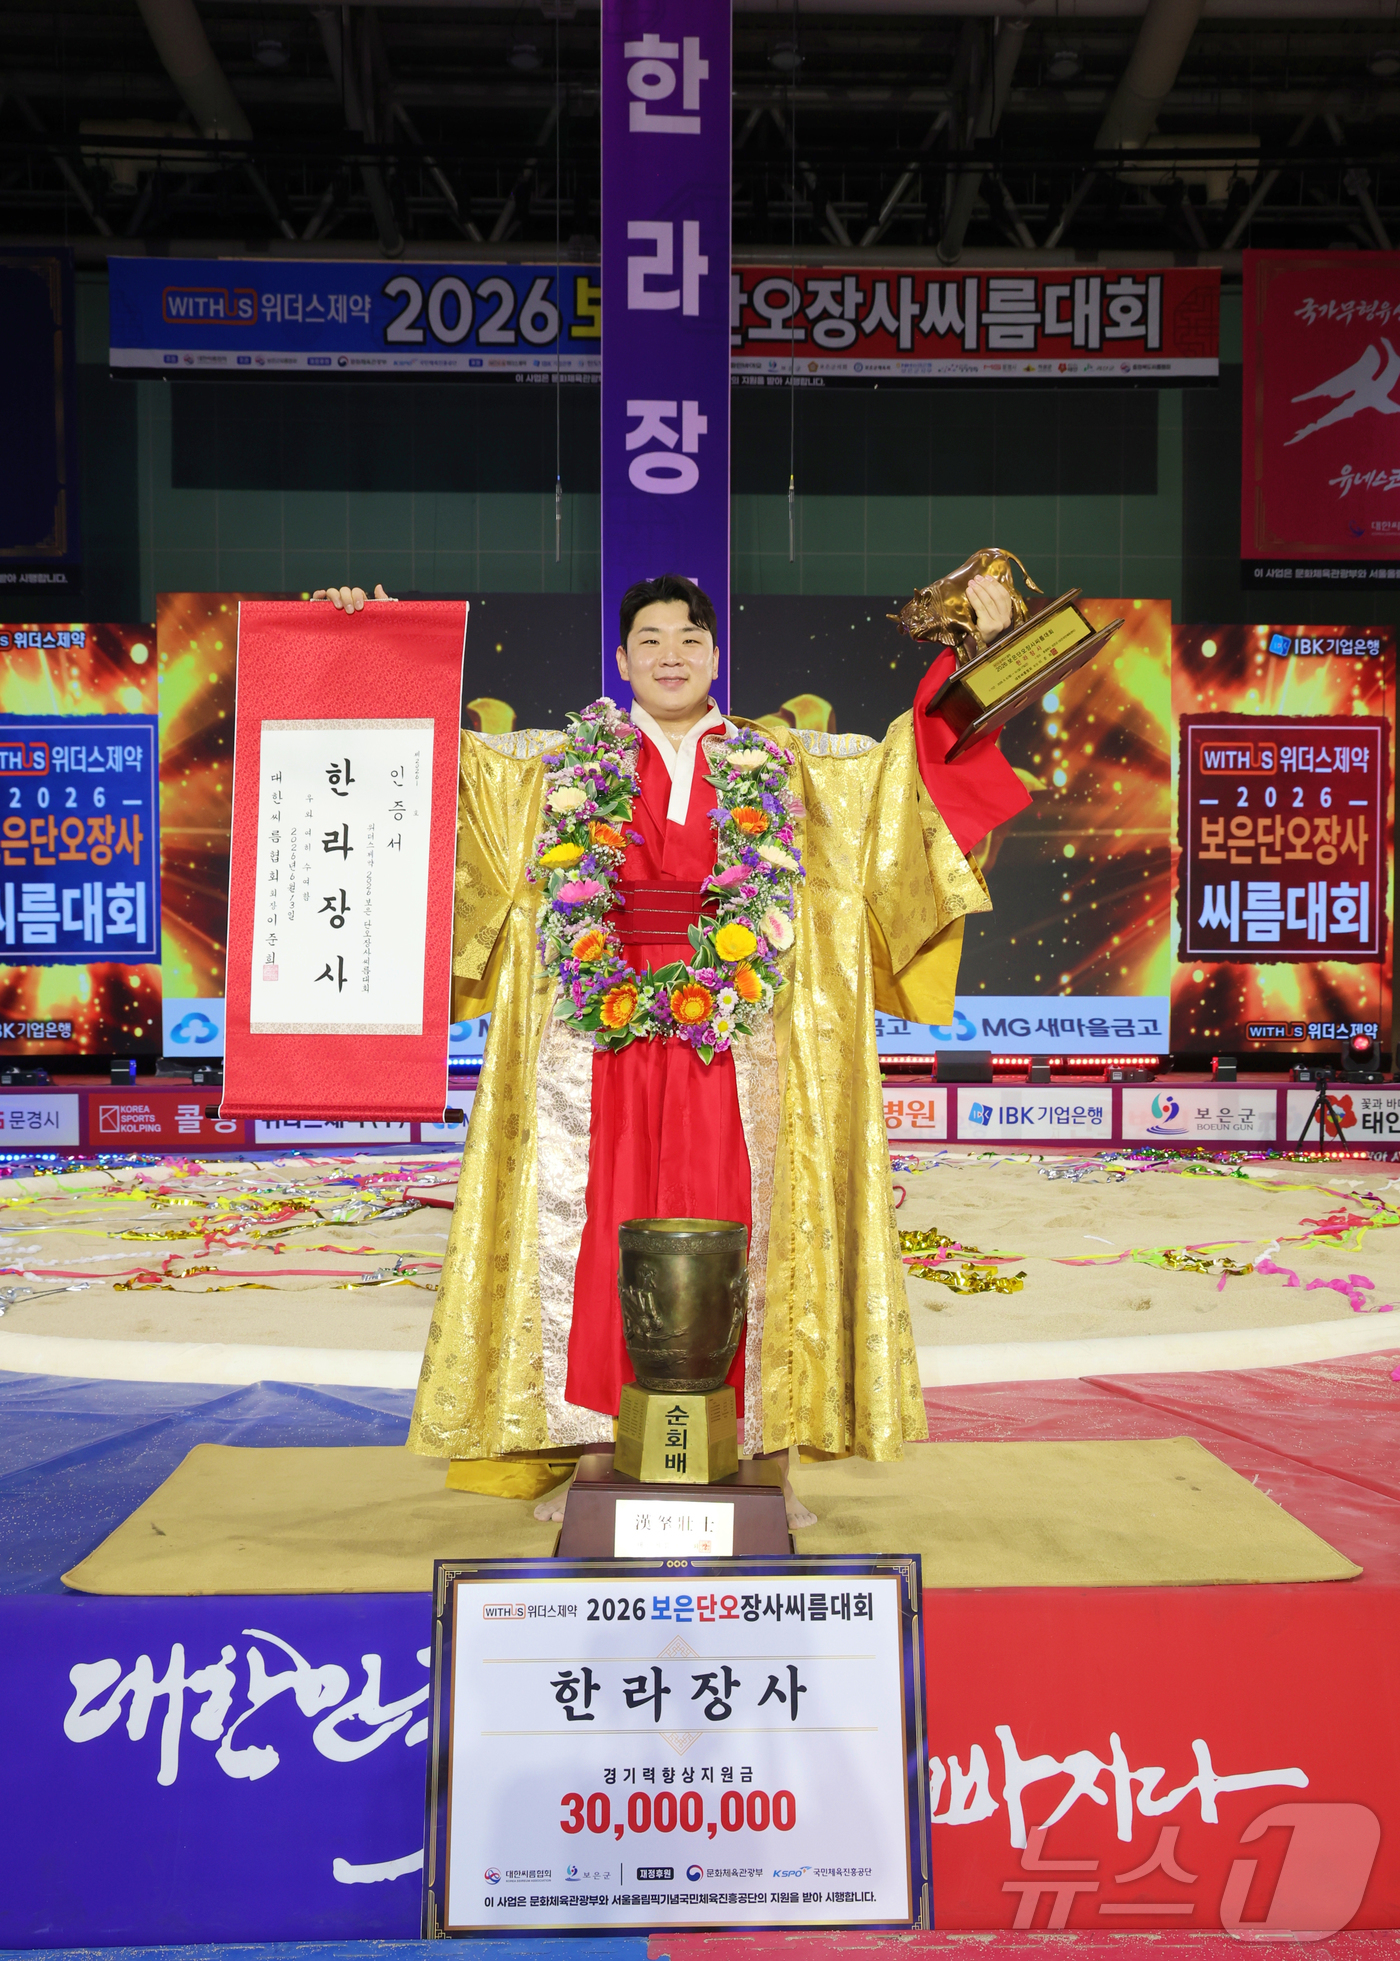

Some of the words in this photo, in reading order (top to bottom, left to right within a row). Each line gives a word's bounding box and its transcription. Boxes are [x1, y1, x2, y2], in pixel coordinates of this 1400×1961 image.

[167, 293, 254, 320] WITHUS
[261, 292, 372, 324] 위더스제약
[383, 276, 561, 346] 2026
[551, 374, 601, 384] 문화체육관광
[1254, 568, 1263, 578] 이
[1265, 568, 1293, 579] 사업은
[1295, 568, 1367, 579] 문화체육관광부와
[14, 631, 86, 649] 위더스제약
[1294, 639, 1324, 655] IBK
[1326, 638, 1380, 655] 기업은행
[52, 745, 143, 773] 위더스제약
[1203, 748, 1275, 771] WITHUS
[1280, 746, 1369, 773] 위더스제약
[387, 765, 406, 852] 인증서
[268, 770, 283, 882] 대한씨름협회
[0, 814, 143, 866] 은단오장사
[1198, 814, 1369, 866] 보은단오장사
[314, 757, 356, 993] 한라장사
[1198, 880, 1369, 943] 씨름대회
[17, 1022, 72, 1039] 기업은행
[982, 1018, 1031, 1038] MG
[1035, 1018, 1162, 1038] 새마을금고
[1249, 1025, 1304, 1038] WITHUS
[121, 1105, 150, 1113] KOREA
[1361, 1098, 1383, 1110] 꽃과
[9, 1111, 59, 1130] 문경시
[121, 1115, 155, 1123] SPORTS
[999, 1106, 1035, 1124] IBK
[1037, 1106, 1103, 1125] 기업은행
[1194, 1107, 1256, 1124] 보은군
[121, 1124, 161, 1133] KOLPING
[1196, 1123, 1230, 1131] BOEUN
[1233, 1123, 1254, 1131] GUN
[665, 1405, 689, 1474] 순회배
[485, 1606, 525, 1618] WITHUS
[527, 1604, 578, 1618] 위더스제약
[586, 1597, 646, 1621] 2026
[651, 1592, 874, 1622] 보은단오장사씨름대회
[549, 1664, 808, 1723] 한라장사
[603, 1766, 754, 1784] 경기력향상지원금
[560, 1789, 797, 1841] 30,000,000
[505, 1869, 552, 1879] 대한씨름협회
[582, 1871, 611, 1880] 보은군
[639, 1869, 672, 1879] 재정후원
[706, 1868, 763, 1878] 문화체육관광부
[772, 1869, 803, 1878] KSPO
[813, 1867, 872, 1878] 국민체육진흥공단
[484, 1896, 494, 1907] 이
[496, 1896, 527, 1907] 사업은
[529, 1894, 610, 1907] 문화체육관광부와
[611, 1892, 767, 1906] 서울올림픽기념국민체육진흥공단의
[770, 1892, 799, 1904] 지원을
[802, 1892, 823, 1904] 받아
[825, 1891, 877, 1903] 시행합니다.
